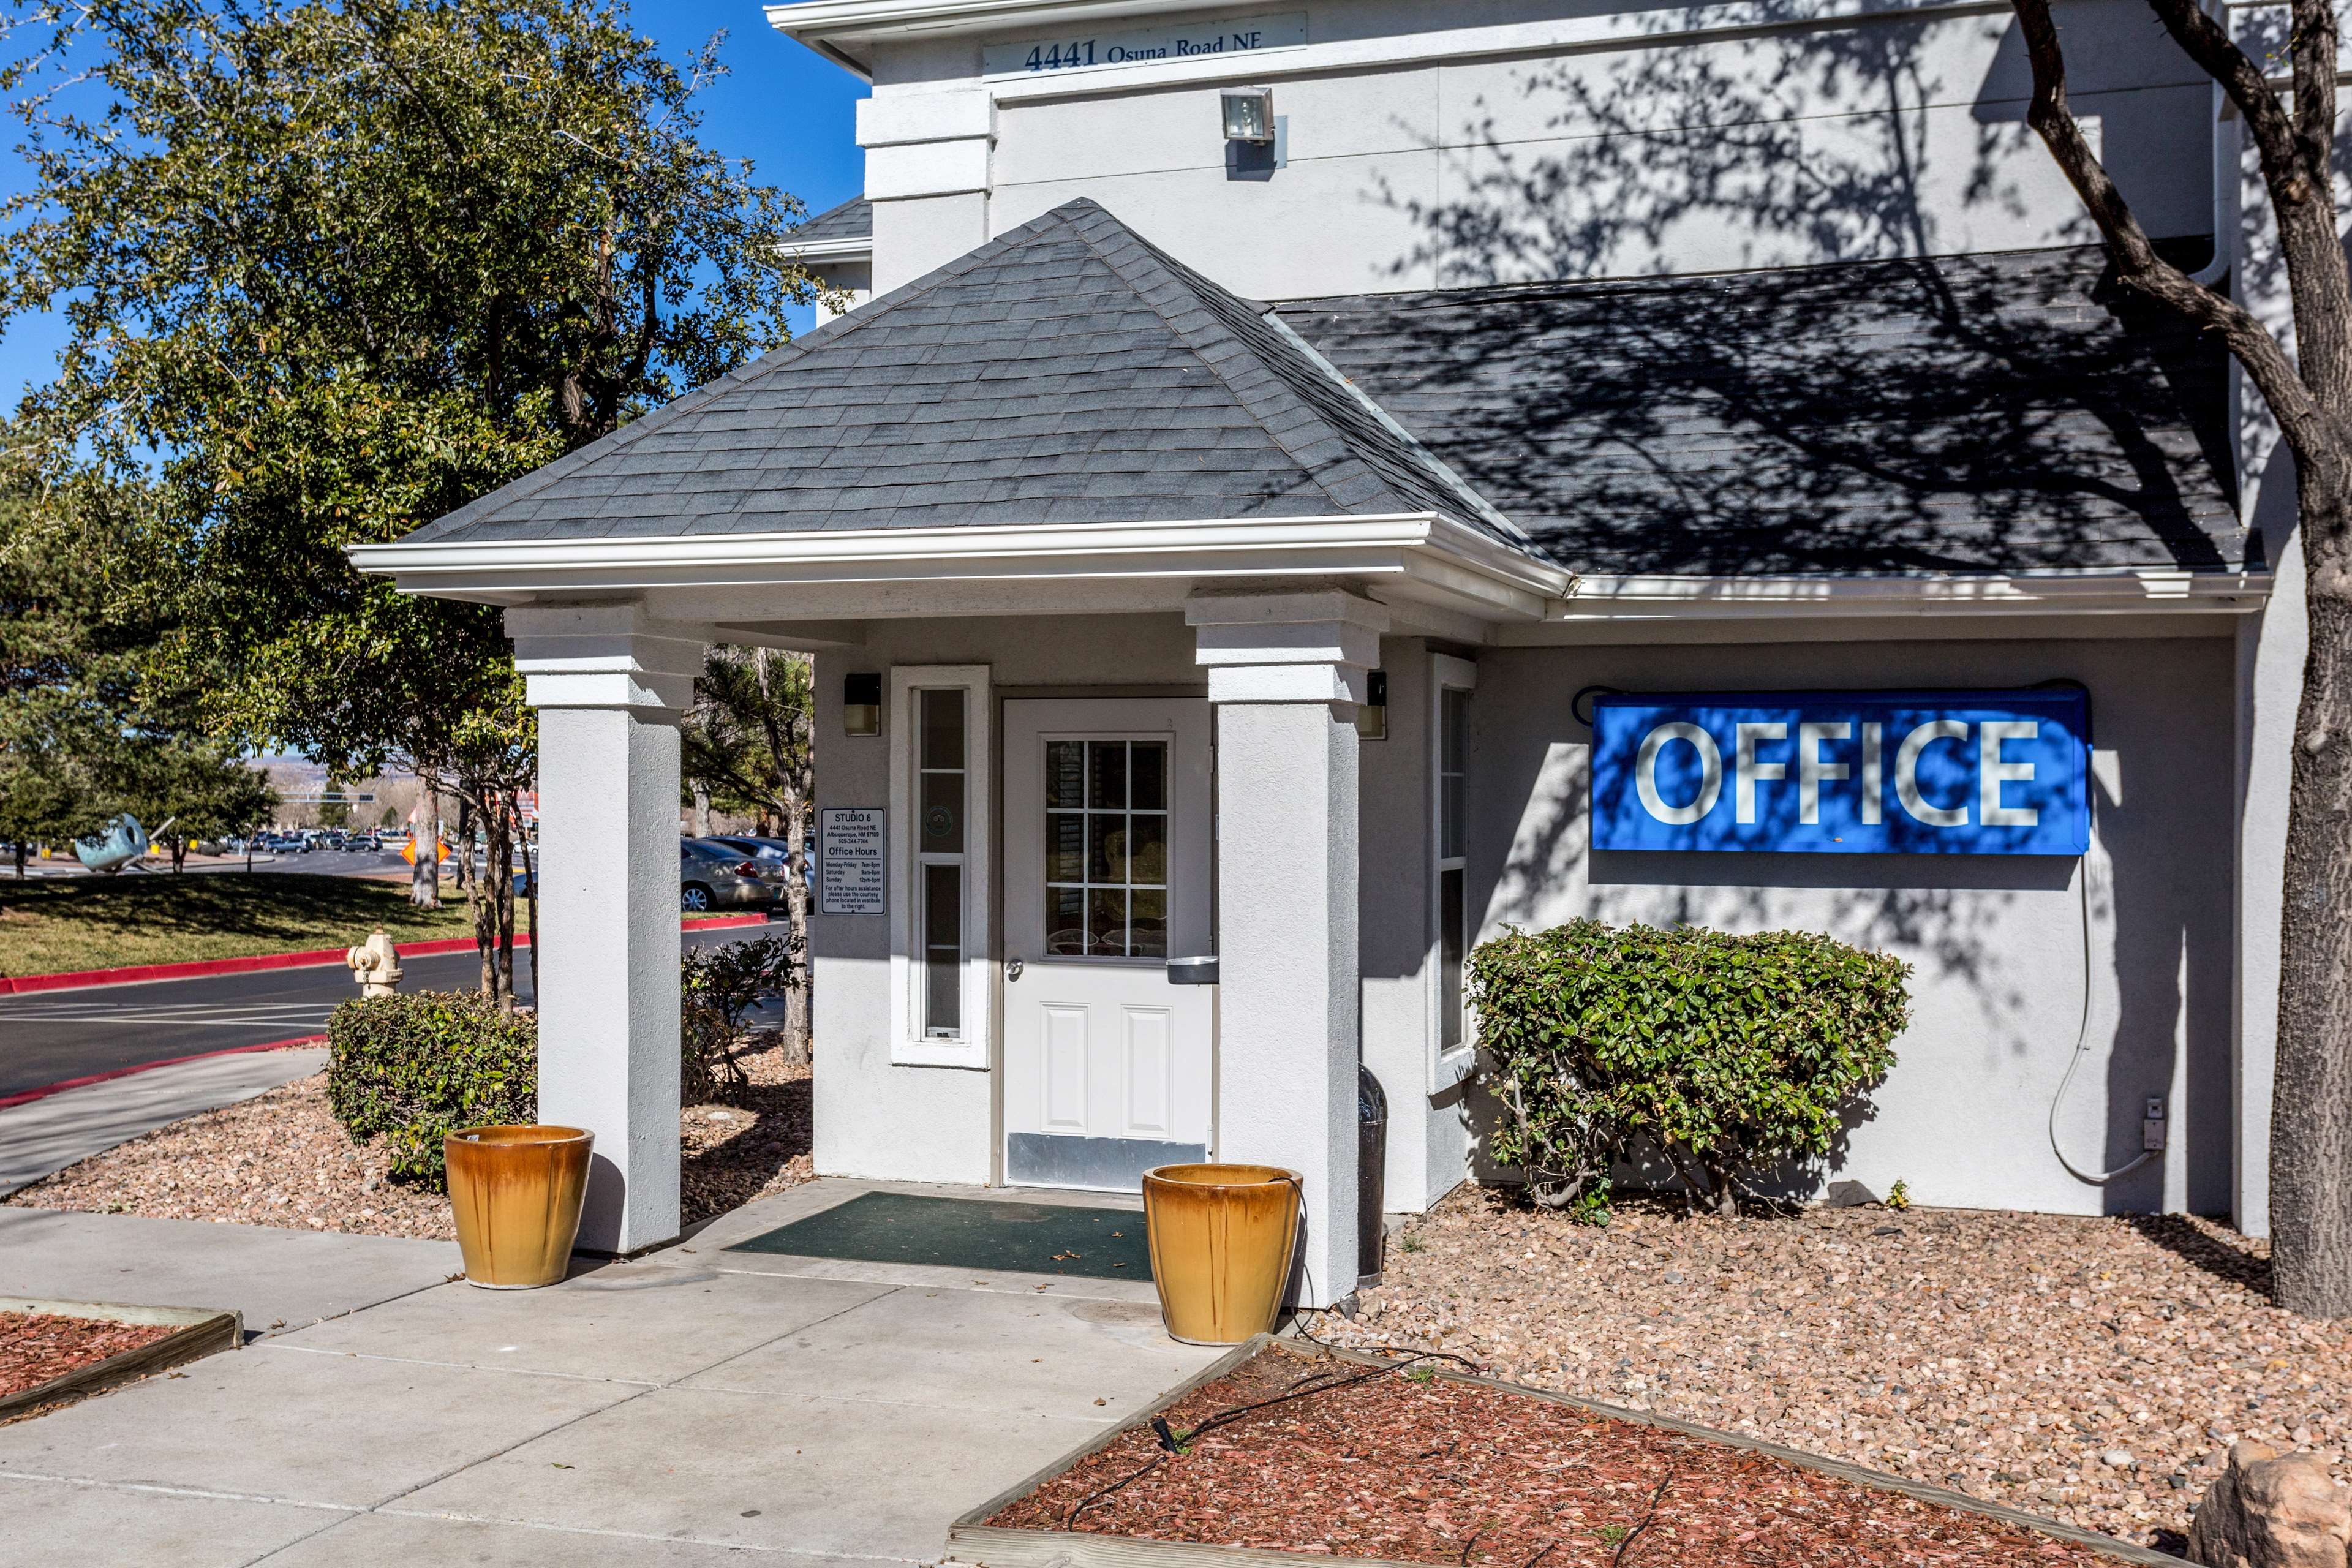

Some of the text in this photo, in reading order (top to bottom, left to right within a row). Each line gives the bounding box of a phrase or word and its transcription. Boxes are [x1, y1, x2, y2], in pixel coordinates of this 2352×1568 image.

[1025, 32, 1261, 72] 4441 Osuna Road NE
[1635, 720, 2038, 827] OFFICE
[835, 813, 871, 822] STUDIO 6
[829, 847, 878, 856] Office Hours
